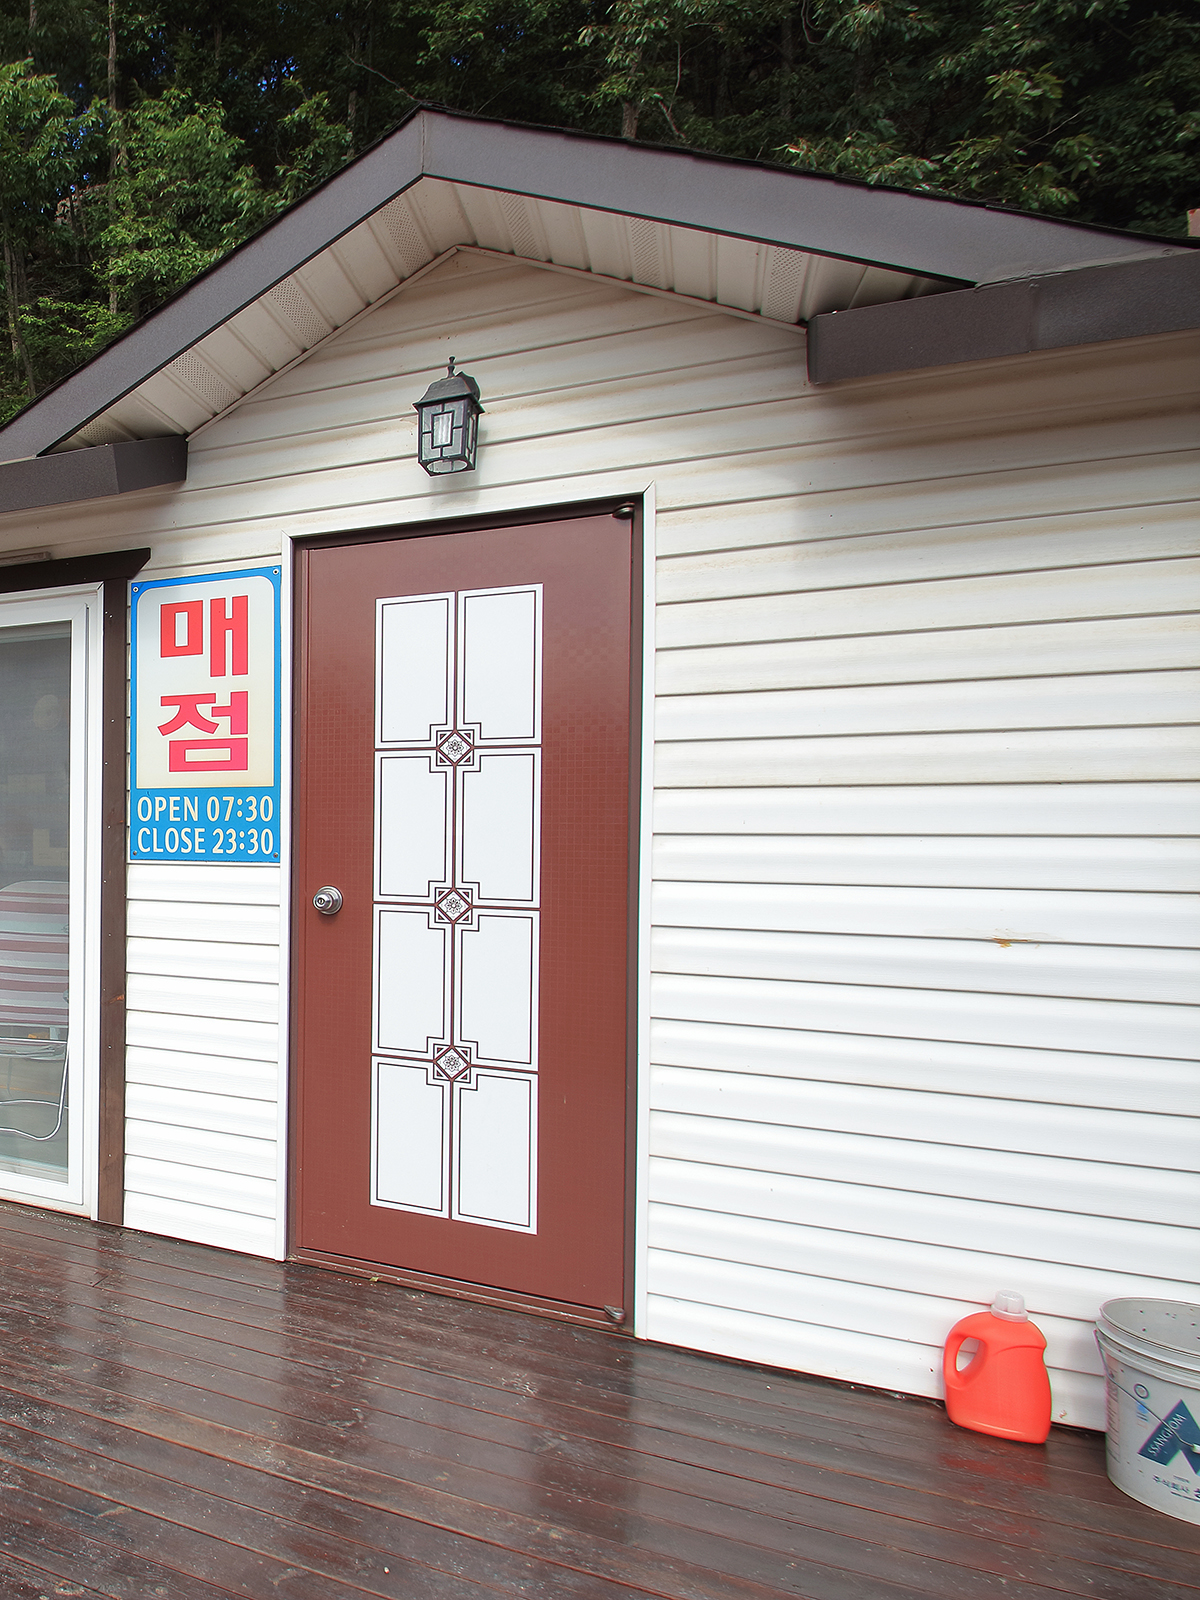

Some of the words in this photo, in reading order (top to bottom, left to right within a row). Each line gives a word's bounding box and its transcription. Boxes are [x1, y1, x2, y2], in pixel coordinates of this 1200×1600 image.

[158, 594, 249, 773] 매점
[137, 796, 199, 822] OPEN
[206, 795, 274, 822] 07:30
[137, 827, 206, 854] CLOSE
[212, 827, 274, 855] 23:30
